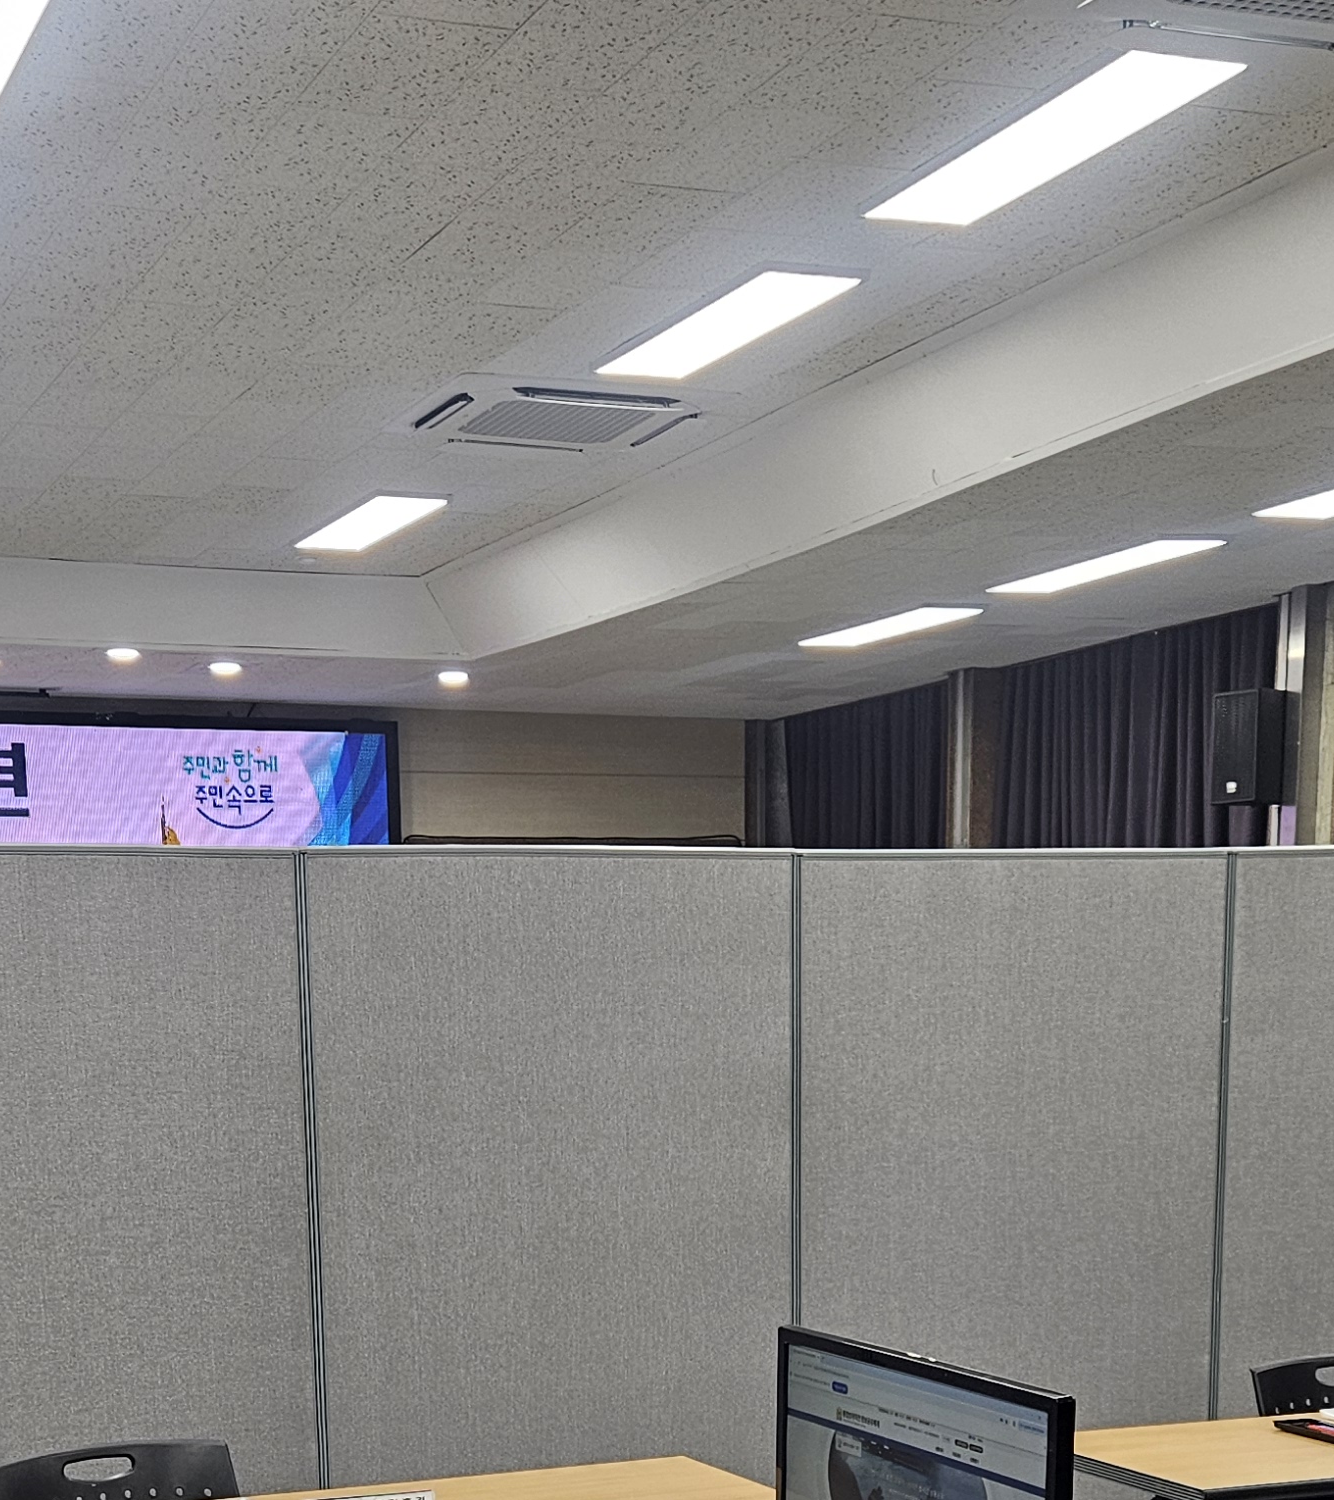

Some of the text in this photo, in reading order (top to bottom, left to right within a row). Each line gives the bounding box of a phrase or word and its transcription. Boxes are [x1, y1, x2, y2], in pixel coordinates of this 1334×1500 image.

[183, 749, 278, 783] 주민과 함께
[195, 785, 275, 815] 주민속으로
